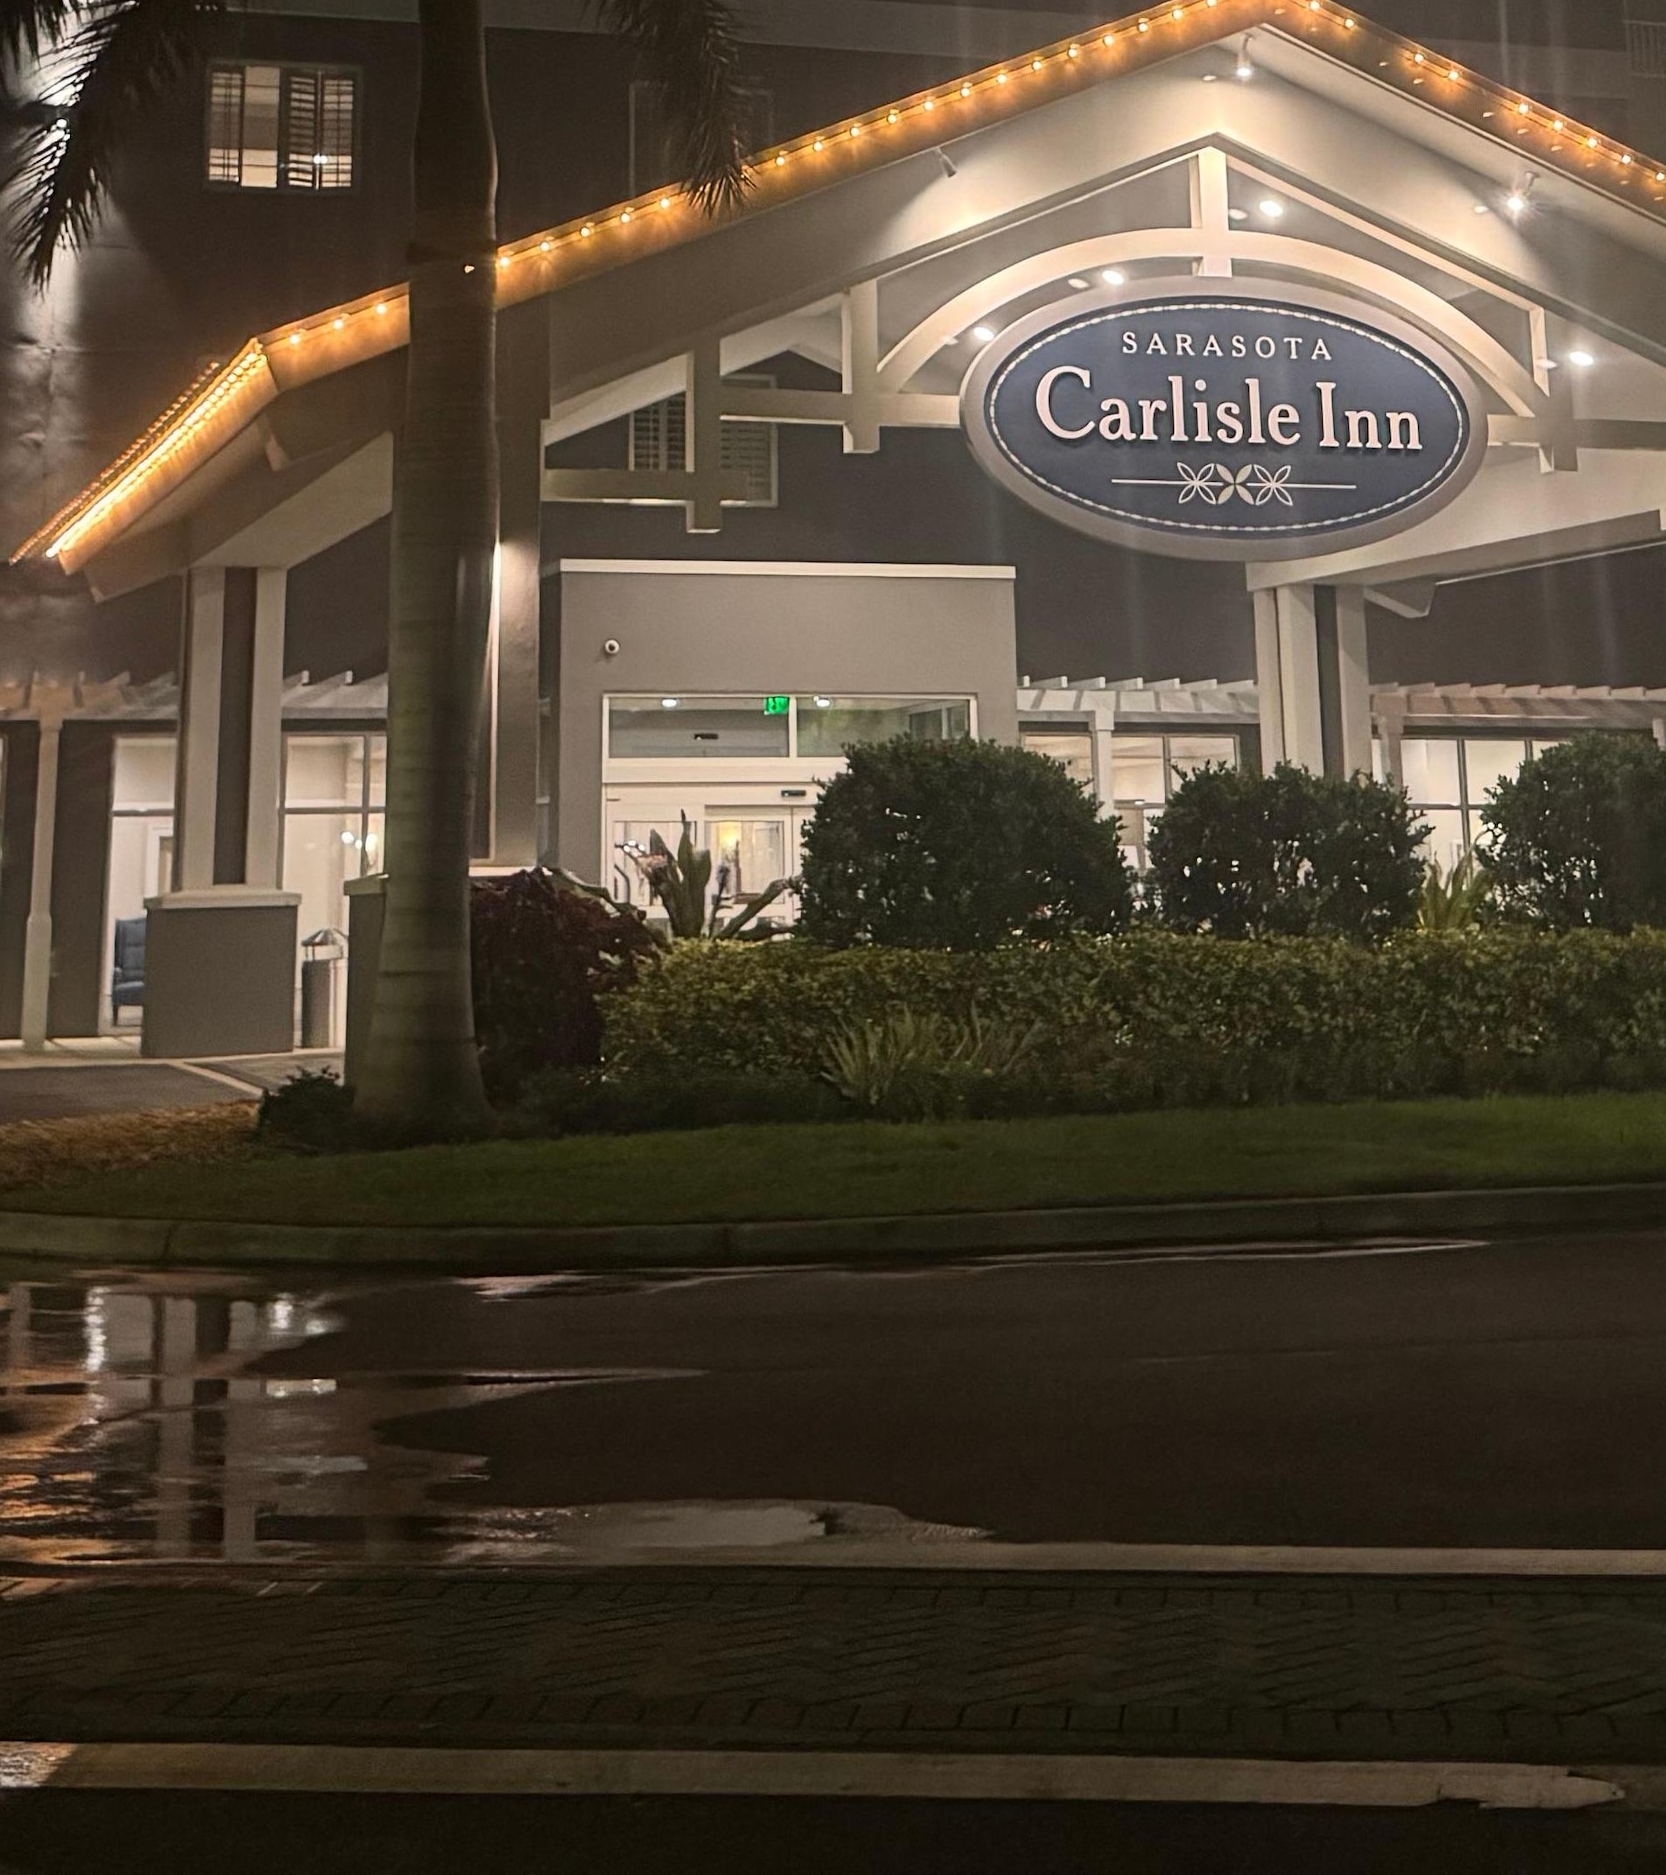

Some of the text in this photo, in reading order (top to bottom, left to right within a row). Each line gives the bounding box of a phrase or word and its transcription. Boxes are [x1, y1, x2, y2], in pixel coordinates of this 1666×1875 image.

[1122, 331, 1332, 360] SARASOTA
[1035, 365, 1423, 450] Carlisle Inn
